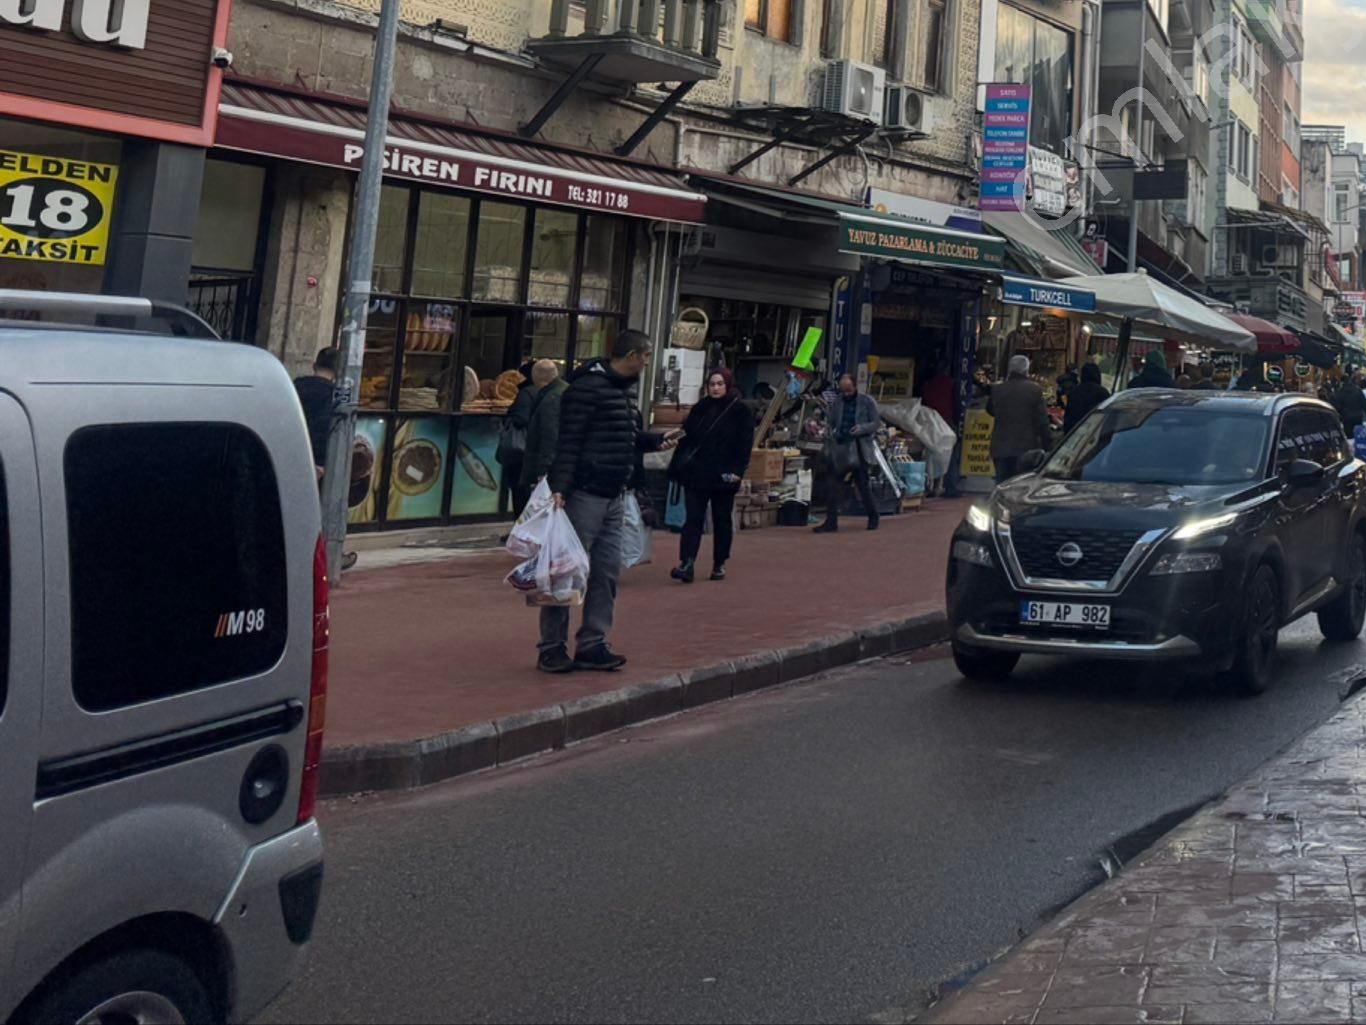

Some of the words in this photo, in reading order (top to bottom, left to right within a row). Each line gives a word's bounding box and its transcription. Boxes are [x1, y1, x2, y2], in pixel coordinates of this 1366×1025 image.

[0, 154, 111, 183] ELDEN
[474, 166, 552, 197] FIRINI
[586, 188, 602, 205] 321
[605, 191, 616, 206] 17
[617, 193, 628, 209] 88
[1, 184, 89, 231] 18
[0, 239, 99, 262] AKSİT
[848, 228, 877, 246] YAVUZ
[878, 234, 928, 253] PAZARLAMA
[1030, 288, 1072, 306] TURKCELL
[1030, 603, 1044, 620] 61
[1054, 604, 1072, 621] AP
[1082, 606, 1107, 623] 982
